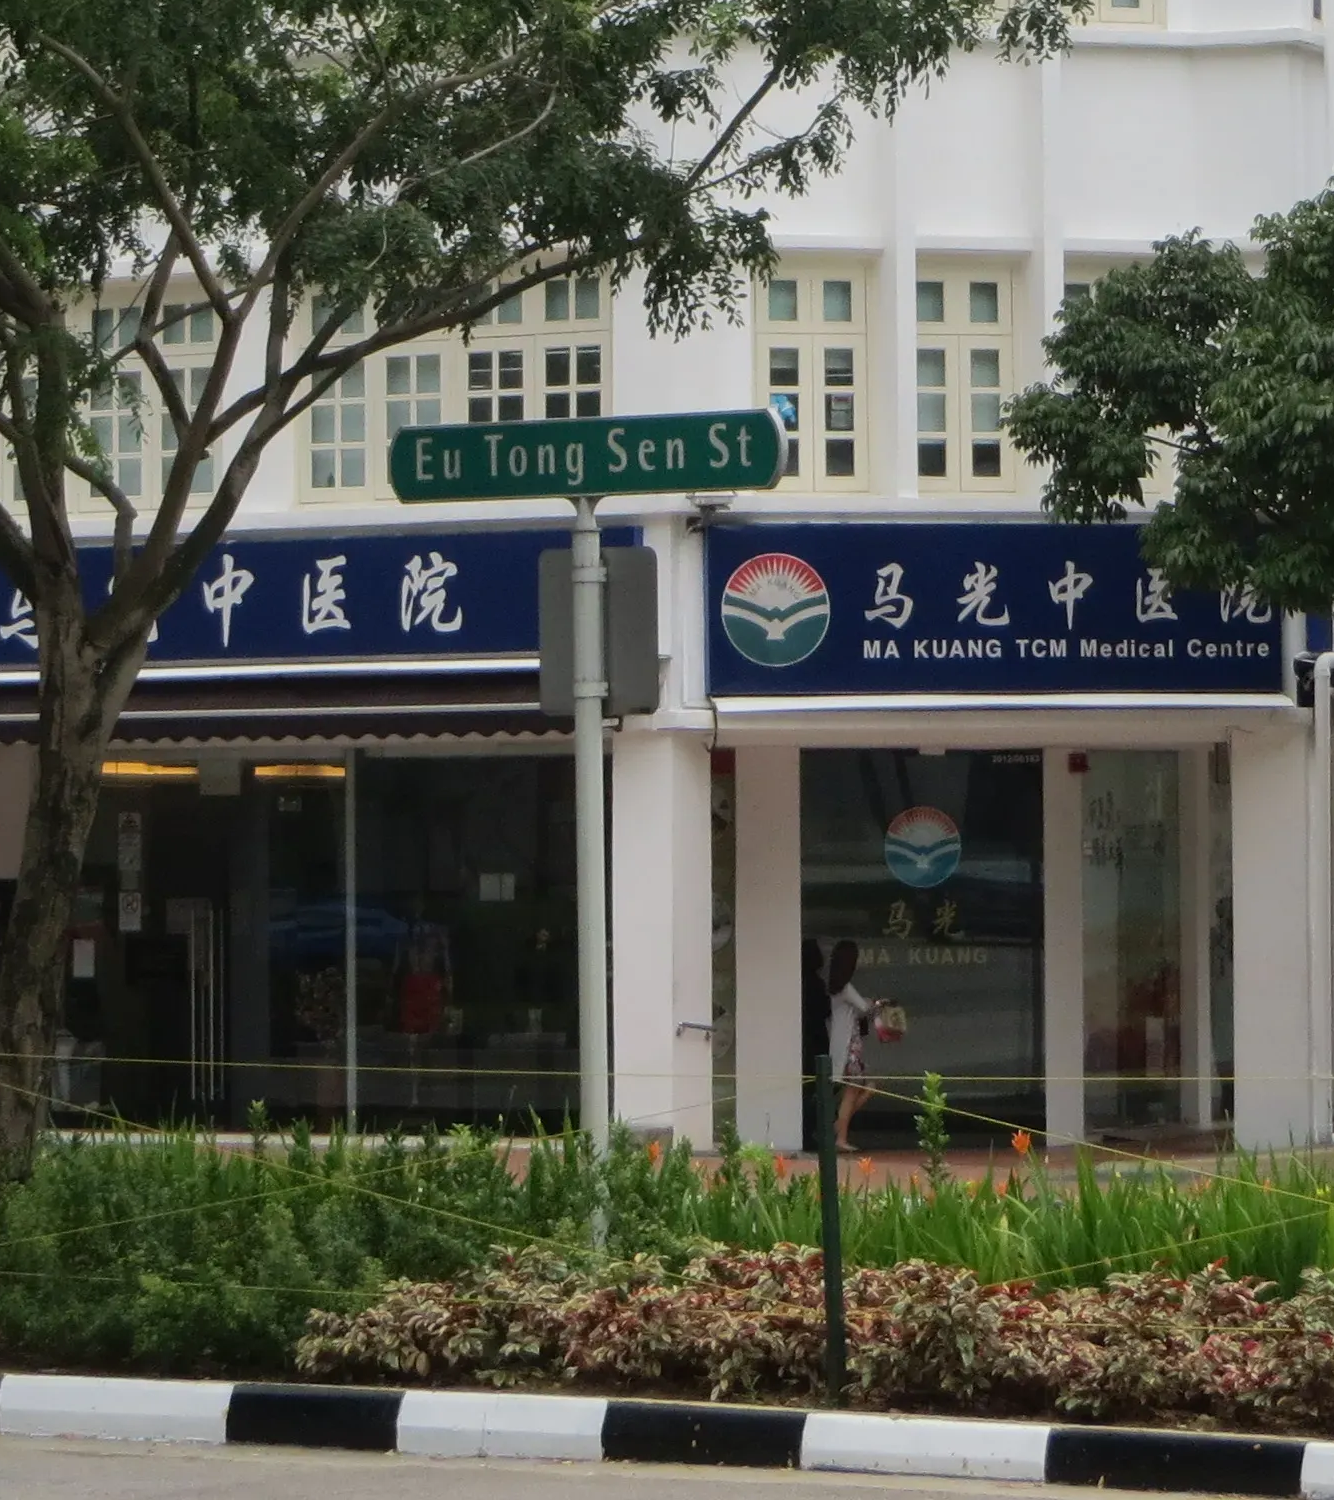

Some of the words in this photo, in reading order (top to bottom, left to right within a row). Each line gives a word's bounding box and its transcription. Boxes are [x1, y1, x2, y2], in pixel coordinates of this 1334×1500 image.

[416, 437, 462, 482] Eu
[485, 432, 584, 486] Tong
[607, 426, 684, 472] Sen
[708, 423, 752, 468] St
[864, 561, 1272, 630] 马光中医院
[863, 640, 900, 659] MA
[914, 639, 1002, 658] KUANG
[1015, 639, 1067, 658] TCM
[1080, 639, 1174, 658] Medical
[1187, 639, 1270, 657] Centre
[881, 898, 965, 940] 马光
[858, 946, 891, 965] MA
[908, 945, 989, 966] KUANG
